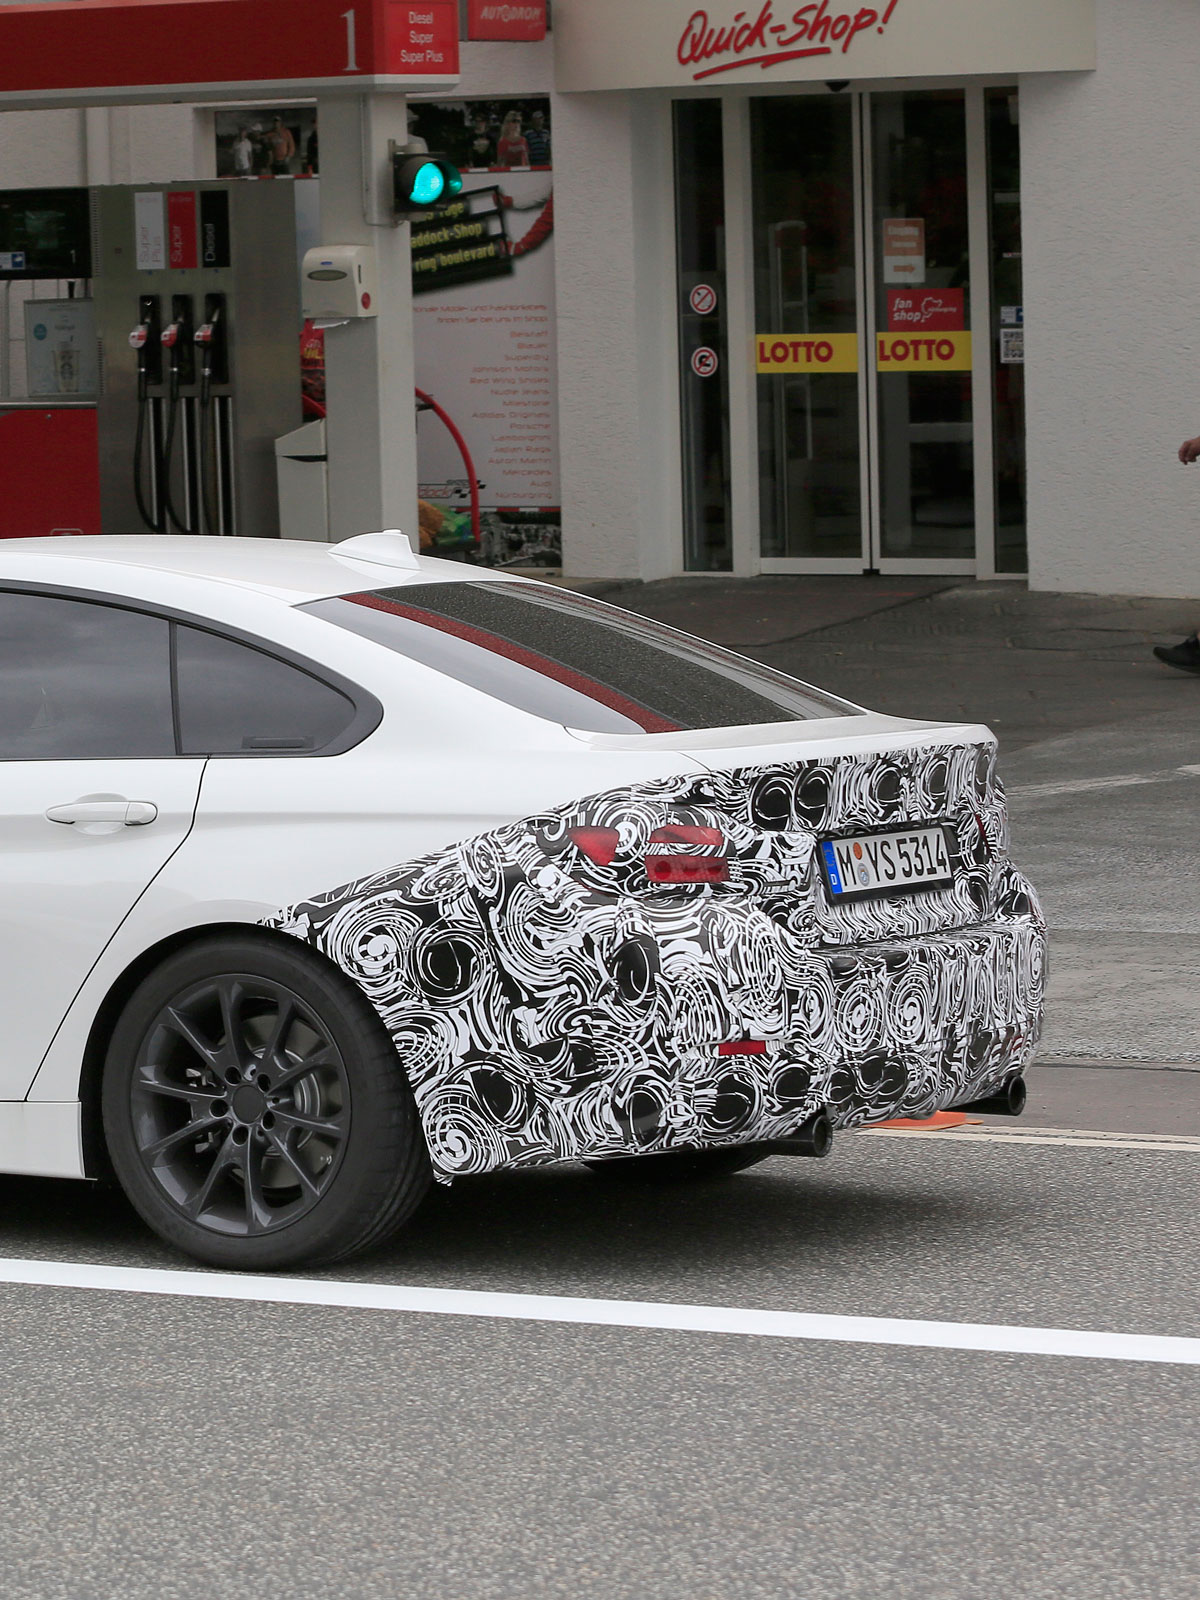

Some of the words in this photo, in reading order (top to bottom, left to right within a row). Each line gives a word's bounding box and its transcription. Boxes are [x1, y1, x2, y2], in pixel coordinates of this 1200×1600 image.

[408, 11, 433, 24] Diesel
[340, 9, 360, 71] 1
[409, 31, 433, 45] Super
[677, 0, 899, 66] Quick-Shop!
[400, 50, 424, 64] Super
[426, 50, 443, 63] Plus
[411, 223, 482, 249] addock-Shop
[893, 297, 913, 311] fan
[893, 311, 922, 323] shop
[759, 341, 834, 363] LOTTO
[878, 338, 955, 361] LOTTO
[830, 873, 838, 886] D
[836, 844, 857, 887] M
[896, 834, 947, 878] 5314
